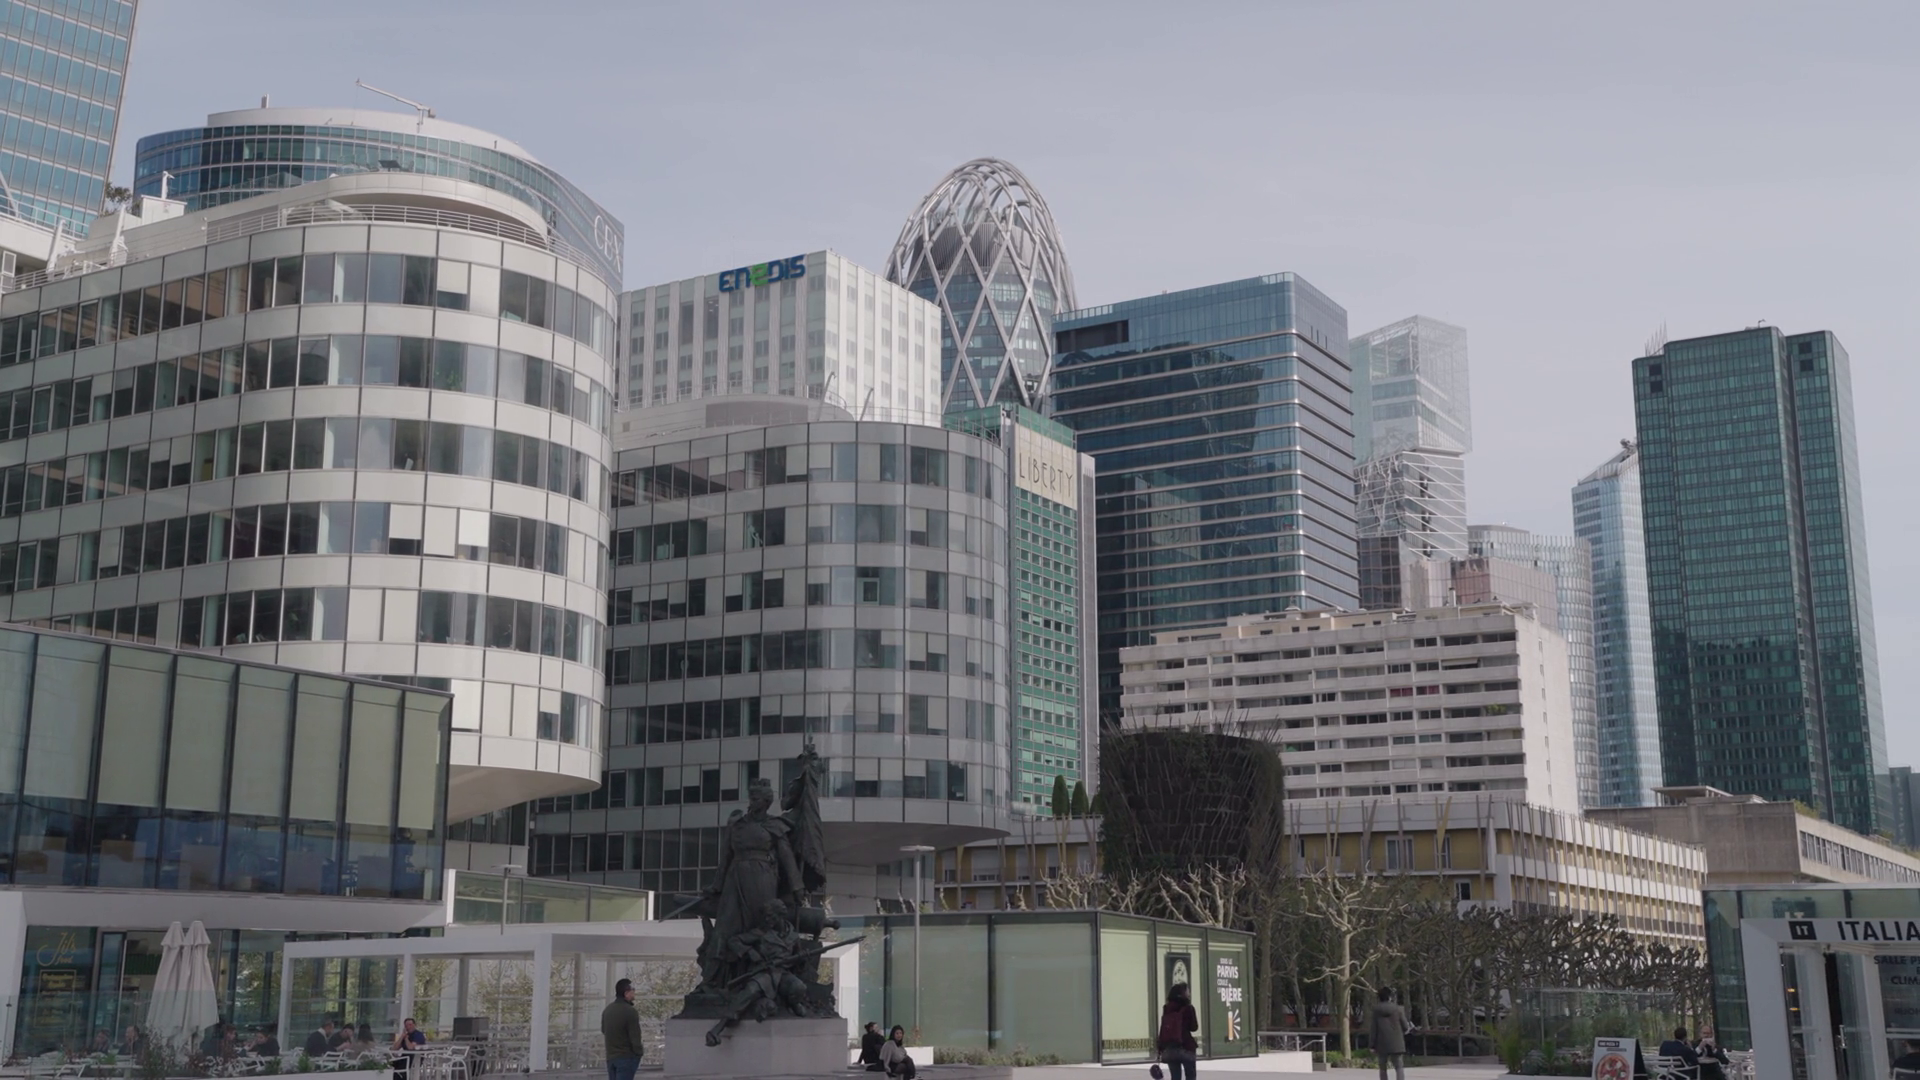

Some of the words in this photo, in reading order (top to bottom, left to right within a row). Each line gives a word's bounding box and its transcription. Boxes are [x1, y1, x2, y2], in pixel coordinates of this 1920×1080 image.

[594, 215, 621, 273] CBX
[1019, 453, 1073, 497] LIBERTY
[1796, 925, 1808, 936] IT
[1874, 955, 1907, 965] SALLE
[1217, 965, 1239, 979] PARVIS
[1221, 984, 1242, 1003] BIÈRE
